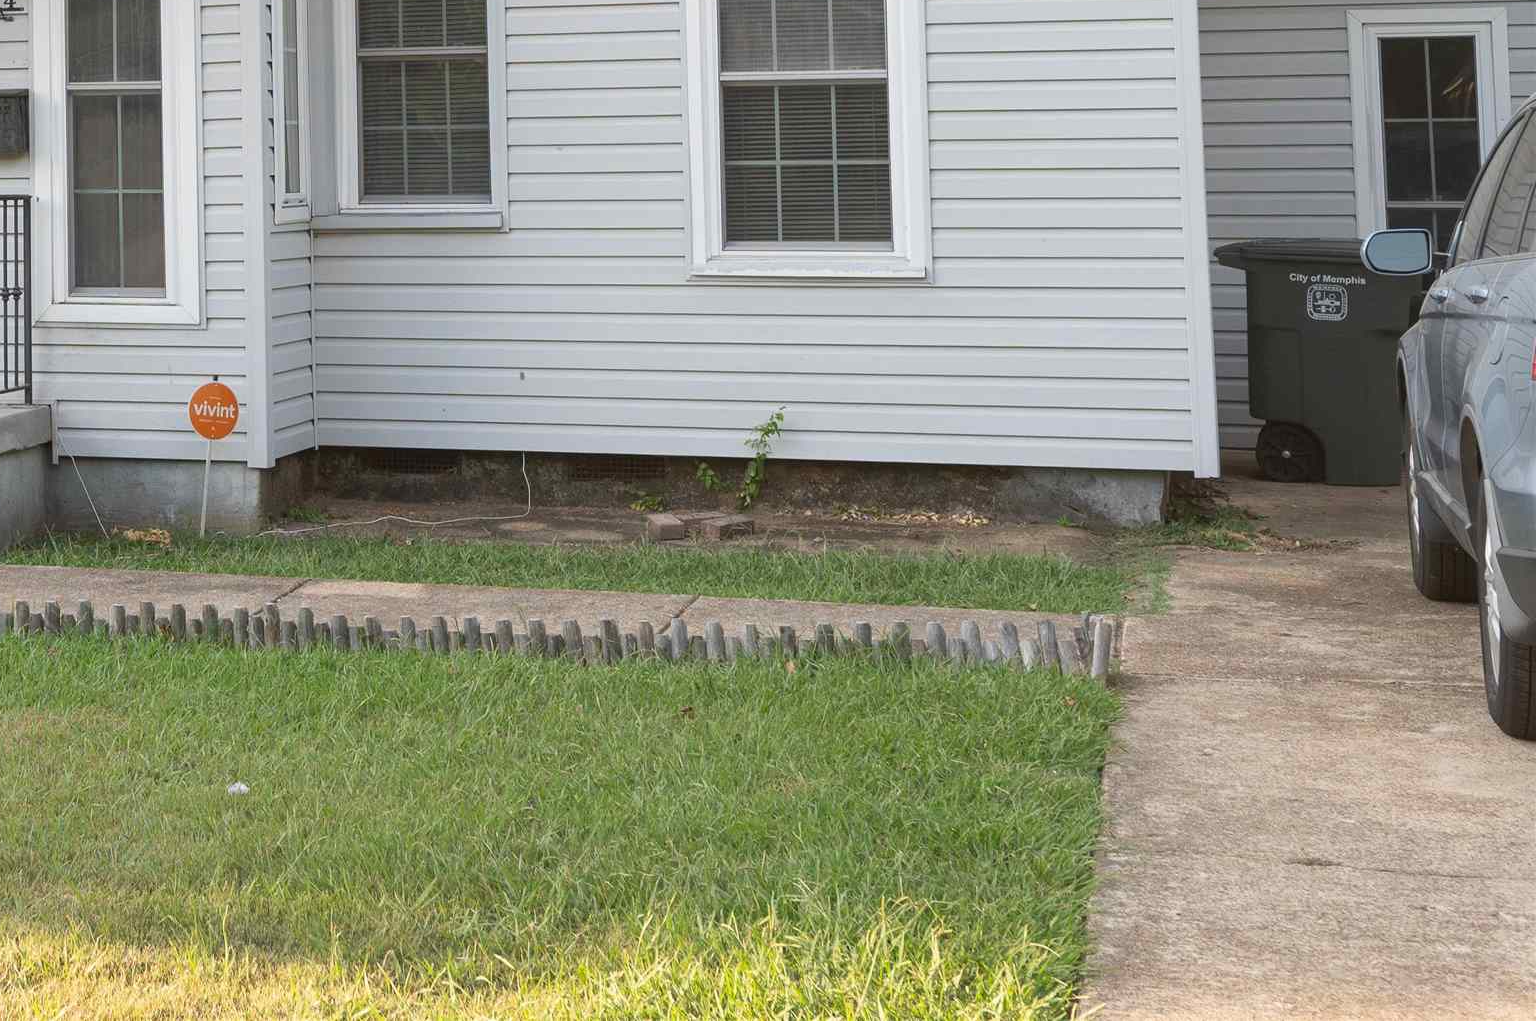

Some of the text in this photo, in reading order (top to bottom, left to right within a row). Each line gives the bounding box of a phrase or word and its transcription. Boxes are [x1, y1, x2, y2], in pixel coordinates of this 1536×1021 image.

[1289, 273, 1366, 285] City of Memphis
[193, 400, 236, 419] vivint
